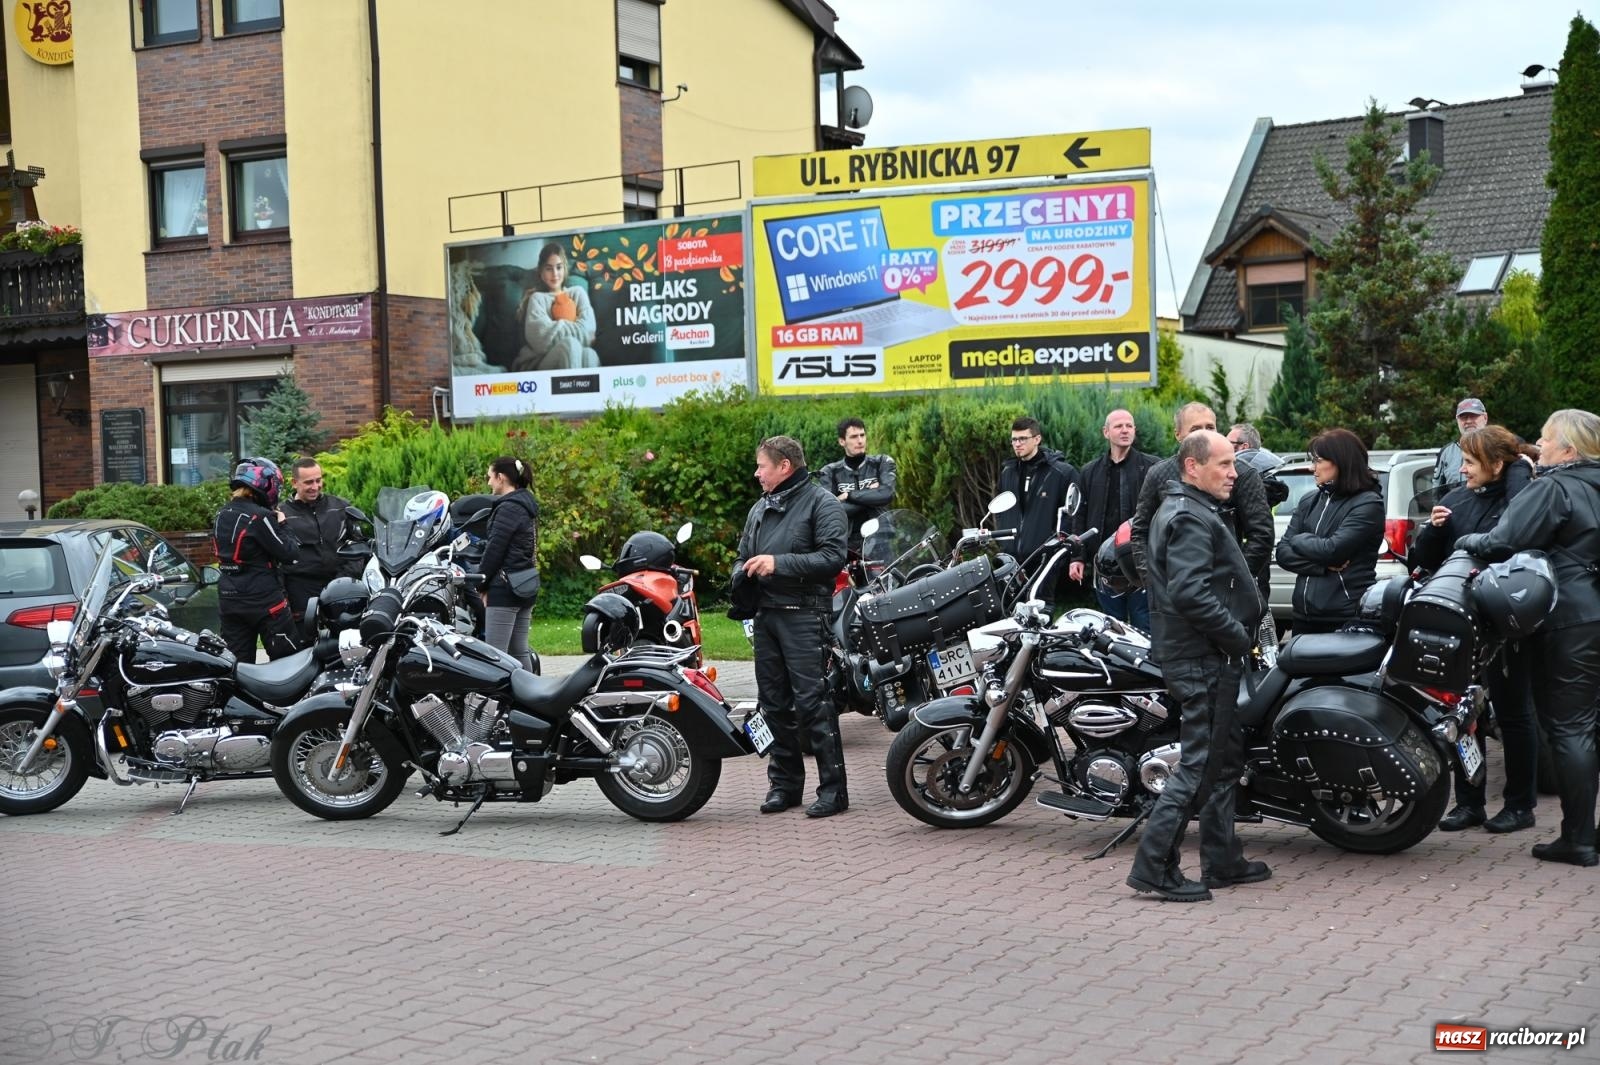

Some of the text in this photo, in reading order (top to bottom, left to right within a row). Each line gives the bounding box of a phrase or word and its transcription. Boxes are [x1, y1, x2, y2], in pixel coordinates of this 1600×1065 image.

[801, 144, 1020, 186] UL. RYBNICKA 97
[940, 193, 1126, 230] PRZECENY!
[776, 217, 878, 261] CORE i7
[1031, 225, 1128, 241] NA URODZINY
[677, 240, 708, 250] SOBOTA
[889, 250, 934, 266] RATY
[810, 264, 879, 292] Windows 11
[884, 266, 921, 290] 0%
[630, 278, 698, 303] RELAKS
[616, 300, 713, 326] I NAGRODY
[1071, 310, 1089, 318] przed
[127, 305, 301, 348] CUKIERNIA
[670, 328, 710, 341] Auchan
[777, 326, 859, 344] 16 GB RAM
[621, 331, 664, 345] w Galerii
[909, 354, 942, 363] LAPTOP
[962, 342, 1113, 367] mediaexpert
[778, 354, 876, 379] ASUS
[613, 376, 634, 389] plus
[656, 371, 708, 387] polsat box
[939, 647, 965, 665] SRC
[939, 661, 972, 680] 41V1
